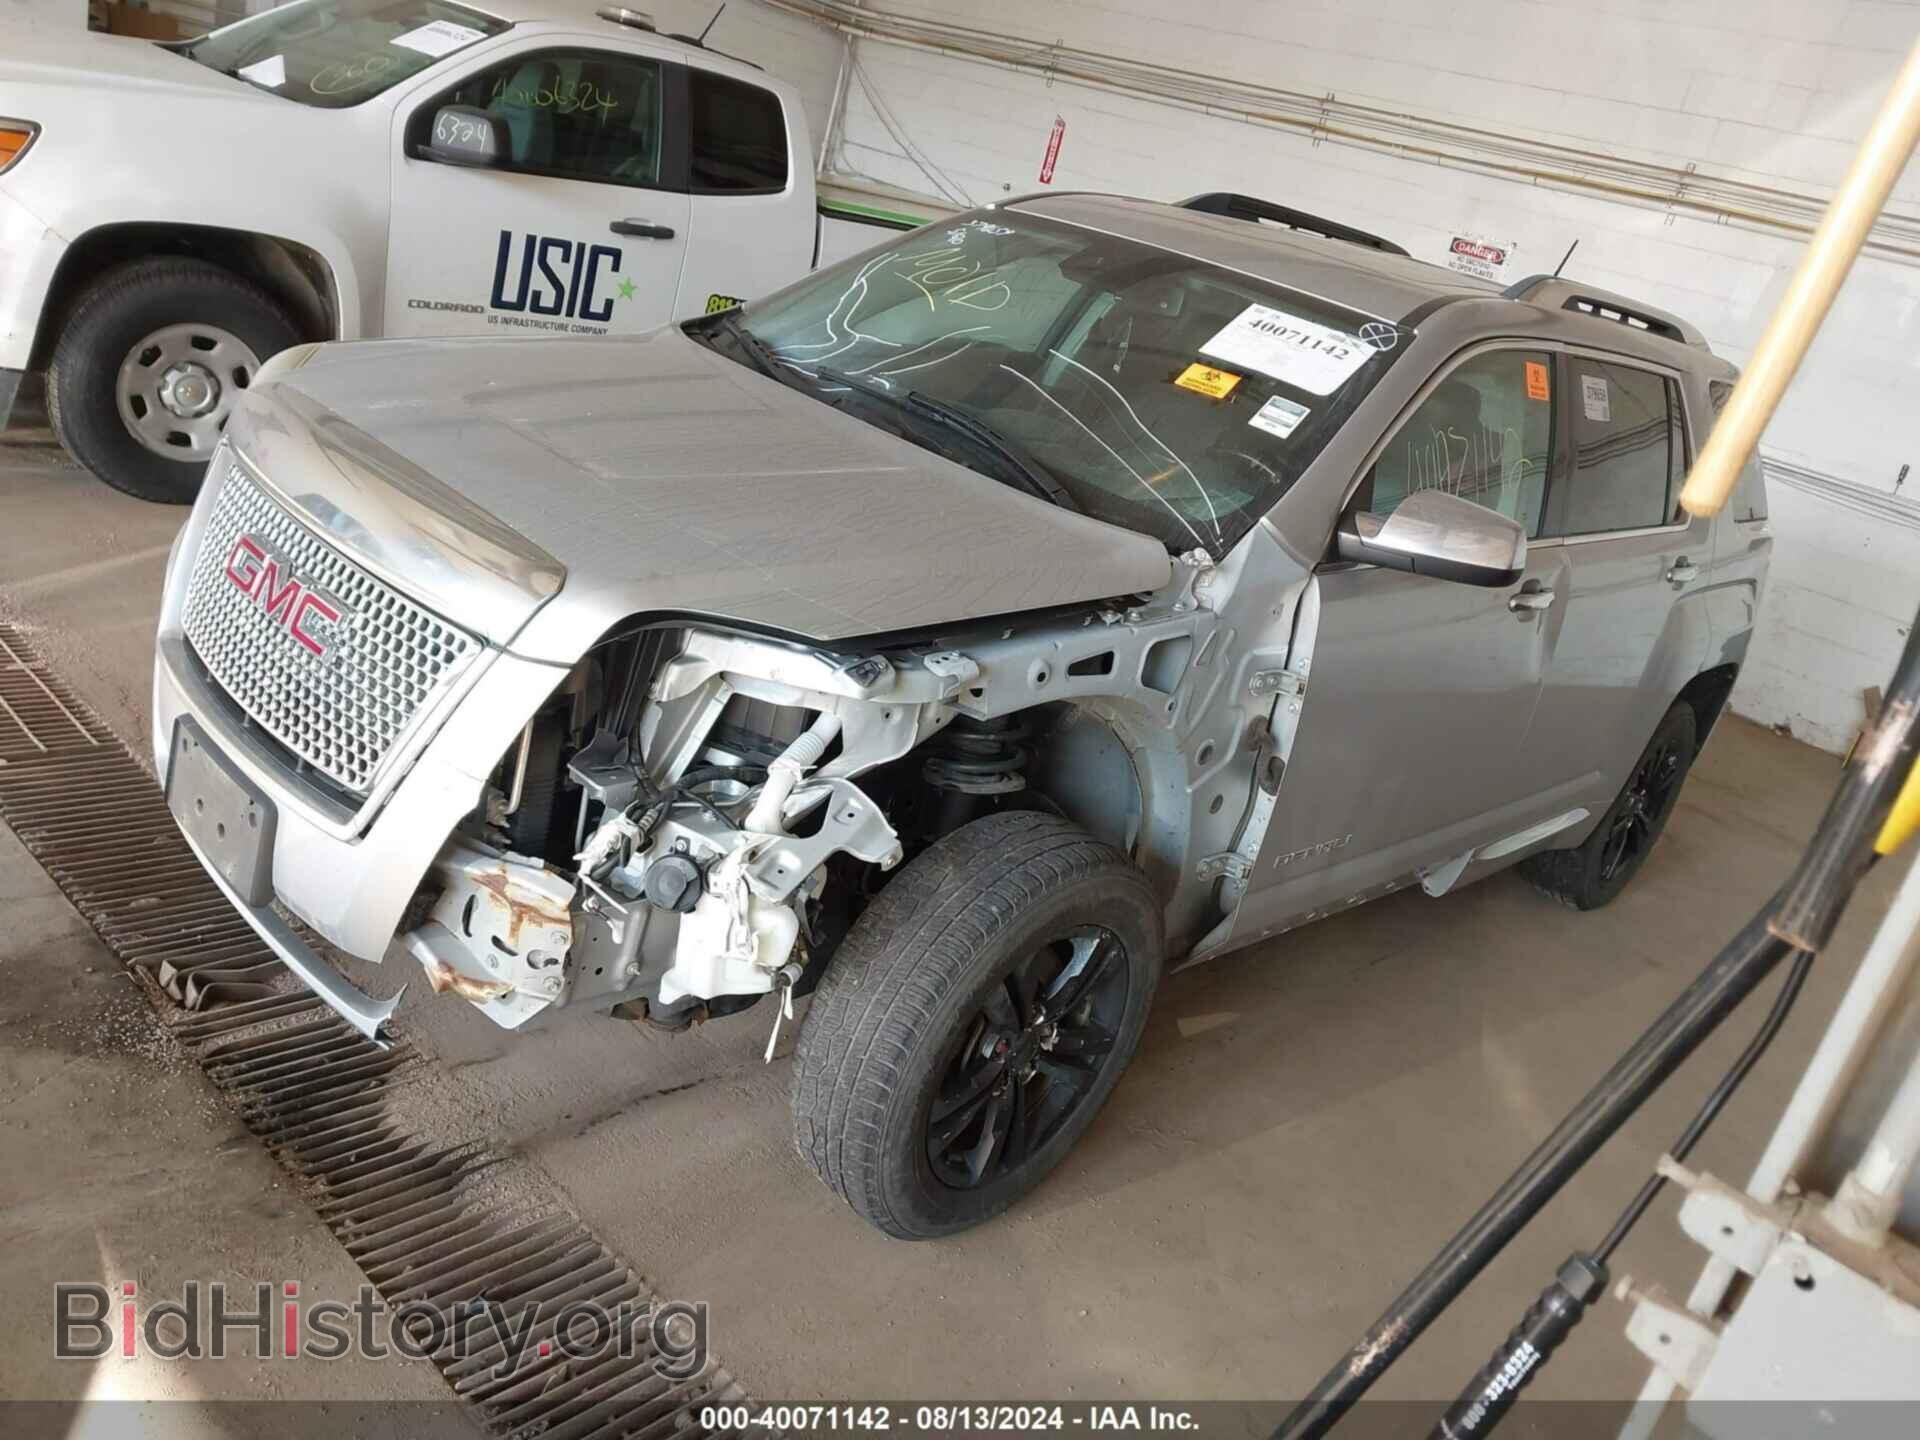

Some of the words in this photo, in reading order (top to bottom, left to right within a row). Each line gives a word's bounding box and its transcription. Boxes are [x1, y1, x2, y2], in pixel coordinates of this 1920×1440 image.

[436, 112, 489, 153] 6324
[1458, 242, 1499, 260] DANGER
[490, 230, 622, 322] USIC
[407, 299, 485, 314] COLORADO
[487, 314, 498, 324] US
[500, 316, 569, 332] INFRASTRUCTURE
[570, 324, 609, 335] COMPANY
[1248, 319, 1350, 361] 40071142
[226, 534, 342, 657] GMC
